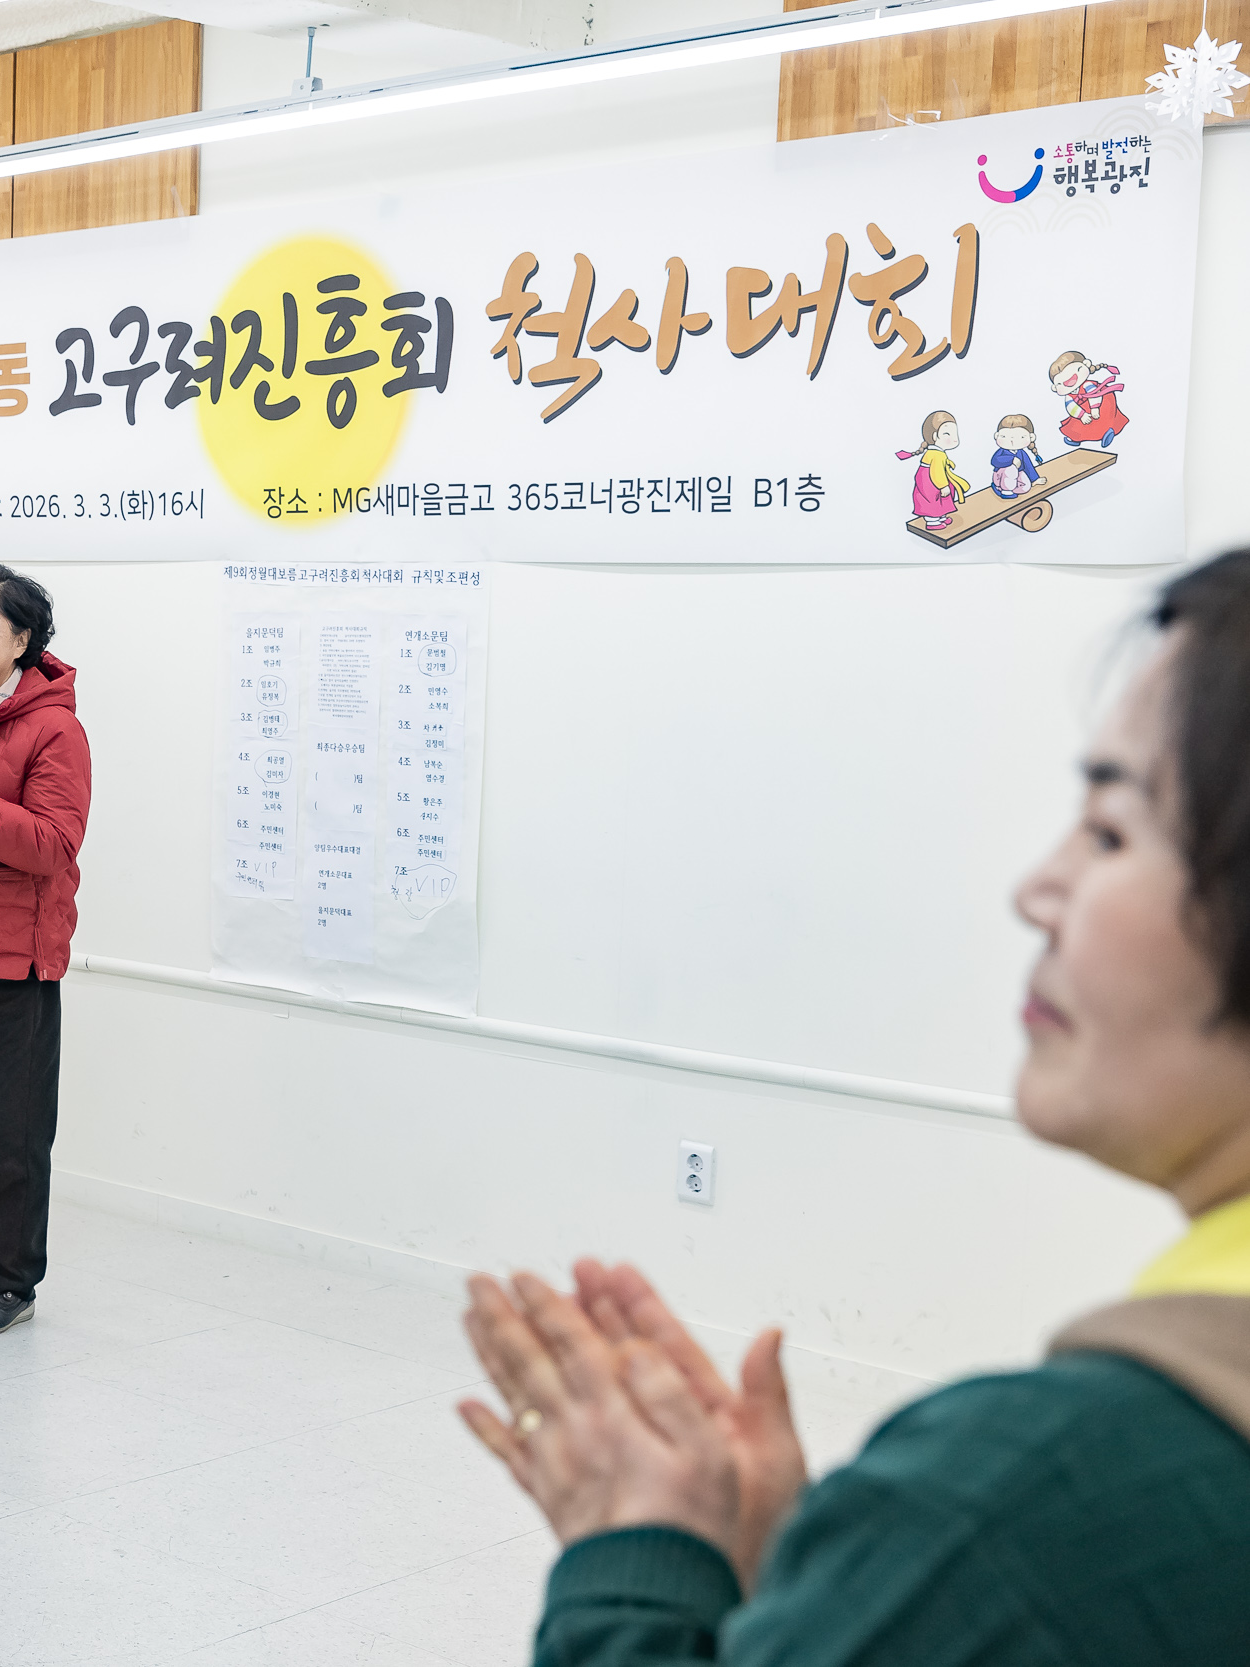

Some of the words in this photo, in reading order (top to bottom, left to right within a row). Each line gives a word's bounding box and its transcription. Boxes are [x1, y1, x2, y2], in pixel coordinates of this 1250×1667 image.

[1053, 140, 1099, 164] 소통하며
[1102, 135, 1152, 160] 발전하는
[1053, 157, 1150, 197] 행복광진
[49, 273, 453, 430] 고구려진흥회
[485, 222, 980, 423] 척사대회
[263, 486, 309, 519] 장소
[333, 482, 495, 517] MG새마을금고
[507, 475, 732, 514] 365코너광진제일
[754, 473, 826, 512] B1층
[10, 494, 67, 519] 2026.
[246, 627, 284, 639] 을지문덕팀
[405, 630, 448, 642] 연개소문팀
[242, 645, 253, 654] 1조
[400, 648, 413, 658] 1조
[240, 678, 253, 688] 2조
[399, 684, 412, 694] 2조
[240, 712, 253, 722] 3조
[398, 719, 412, 730] 3조
[238, 752, 251, 761] 4조
[398, 756, 412, 766] 4조
[237, 785, 250, 795] 5조
[397, 792, 410, 802] 5조
[236, 819, 250, 829] 6조
[396, 827, 410, 838] 6조
[418, 834, 444, 844] 주민센터
[258, 841, 282, 851] 주민센터
[417, 848, 443, 859] 주민센터
[235, 858, 249, 869] 7조
[394, 865, 408, 876] 7조
[415, 875, 451, 898] VIP
